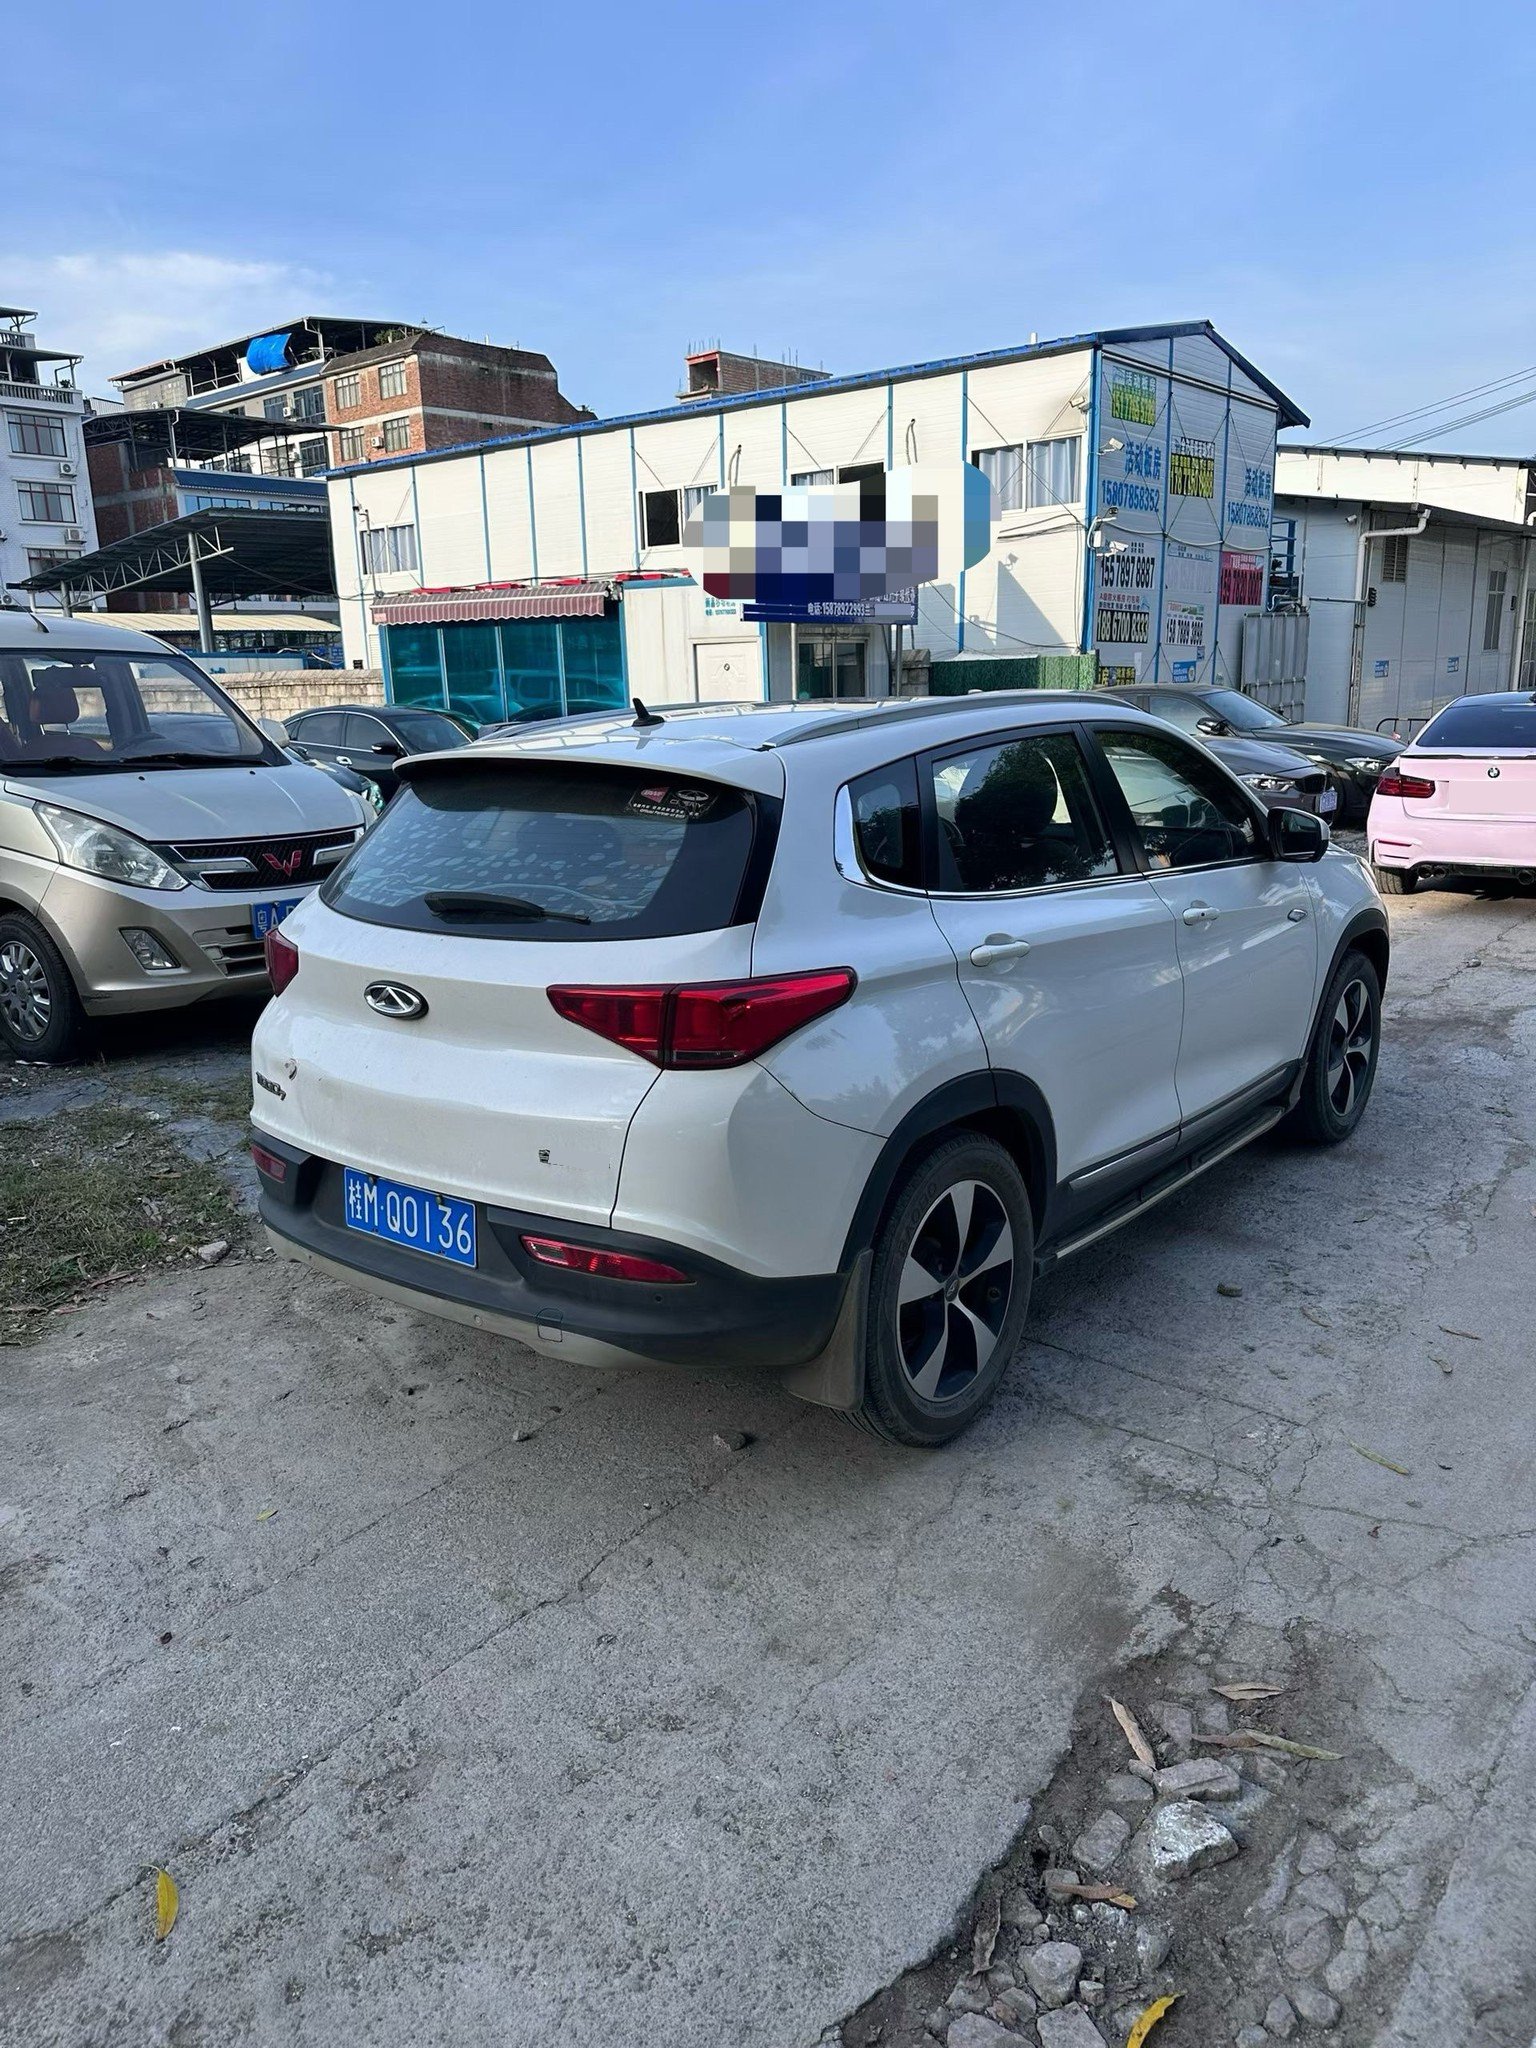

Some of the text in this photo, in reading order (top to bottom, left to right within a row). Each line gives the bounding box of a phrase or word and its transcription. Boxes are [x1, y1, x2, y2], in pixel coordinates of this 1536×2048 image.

[1101, 555, 1115, 588] 155
[1116, 555, 1135, 588] 7897
[1136, 556, 1155, 588] 8887
[1098, 610, 1111, 641] 188
[1112, 612, 1130, 641] 6700
[349, 1178, 472, 1254] 桂M·Q0136
